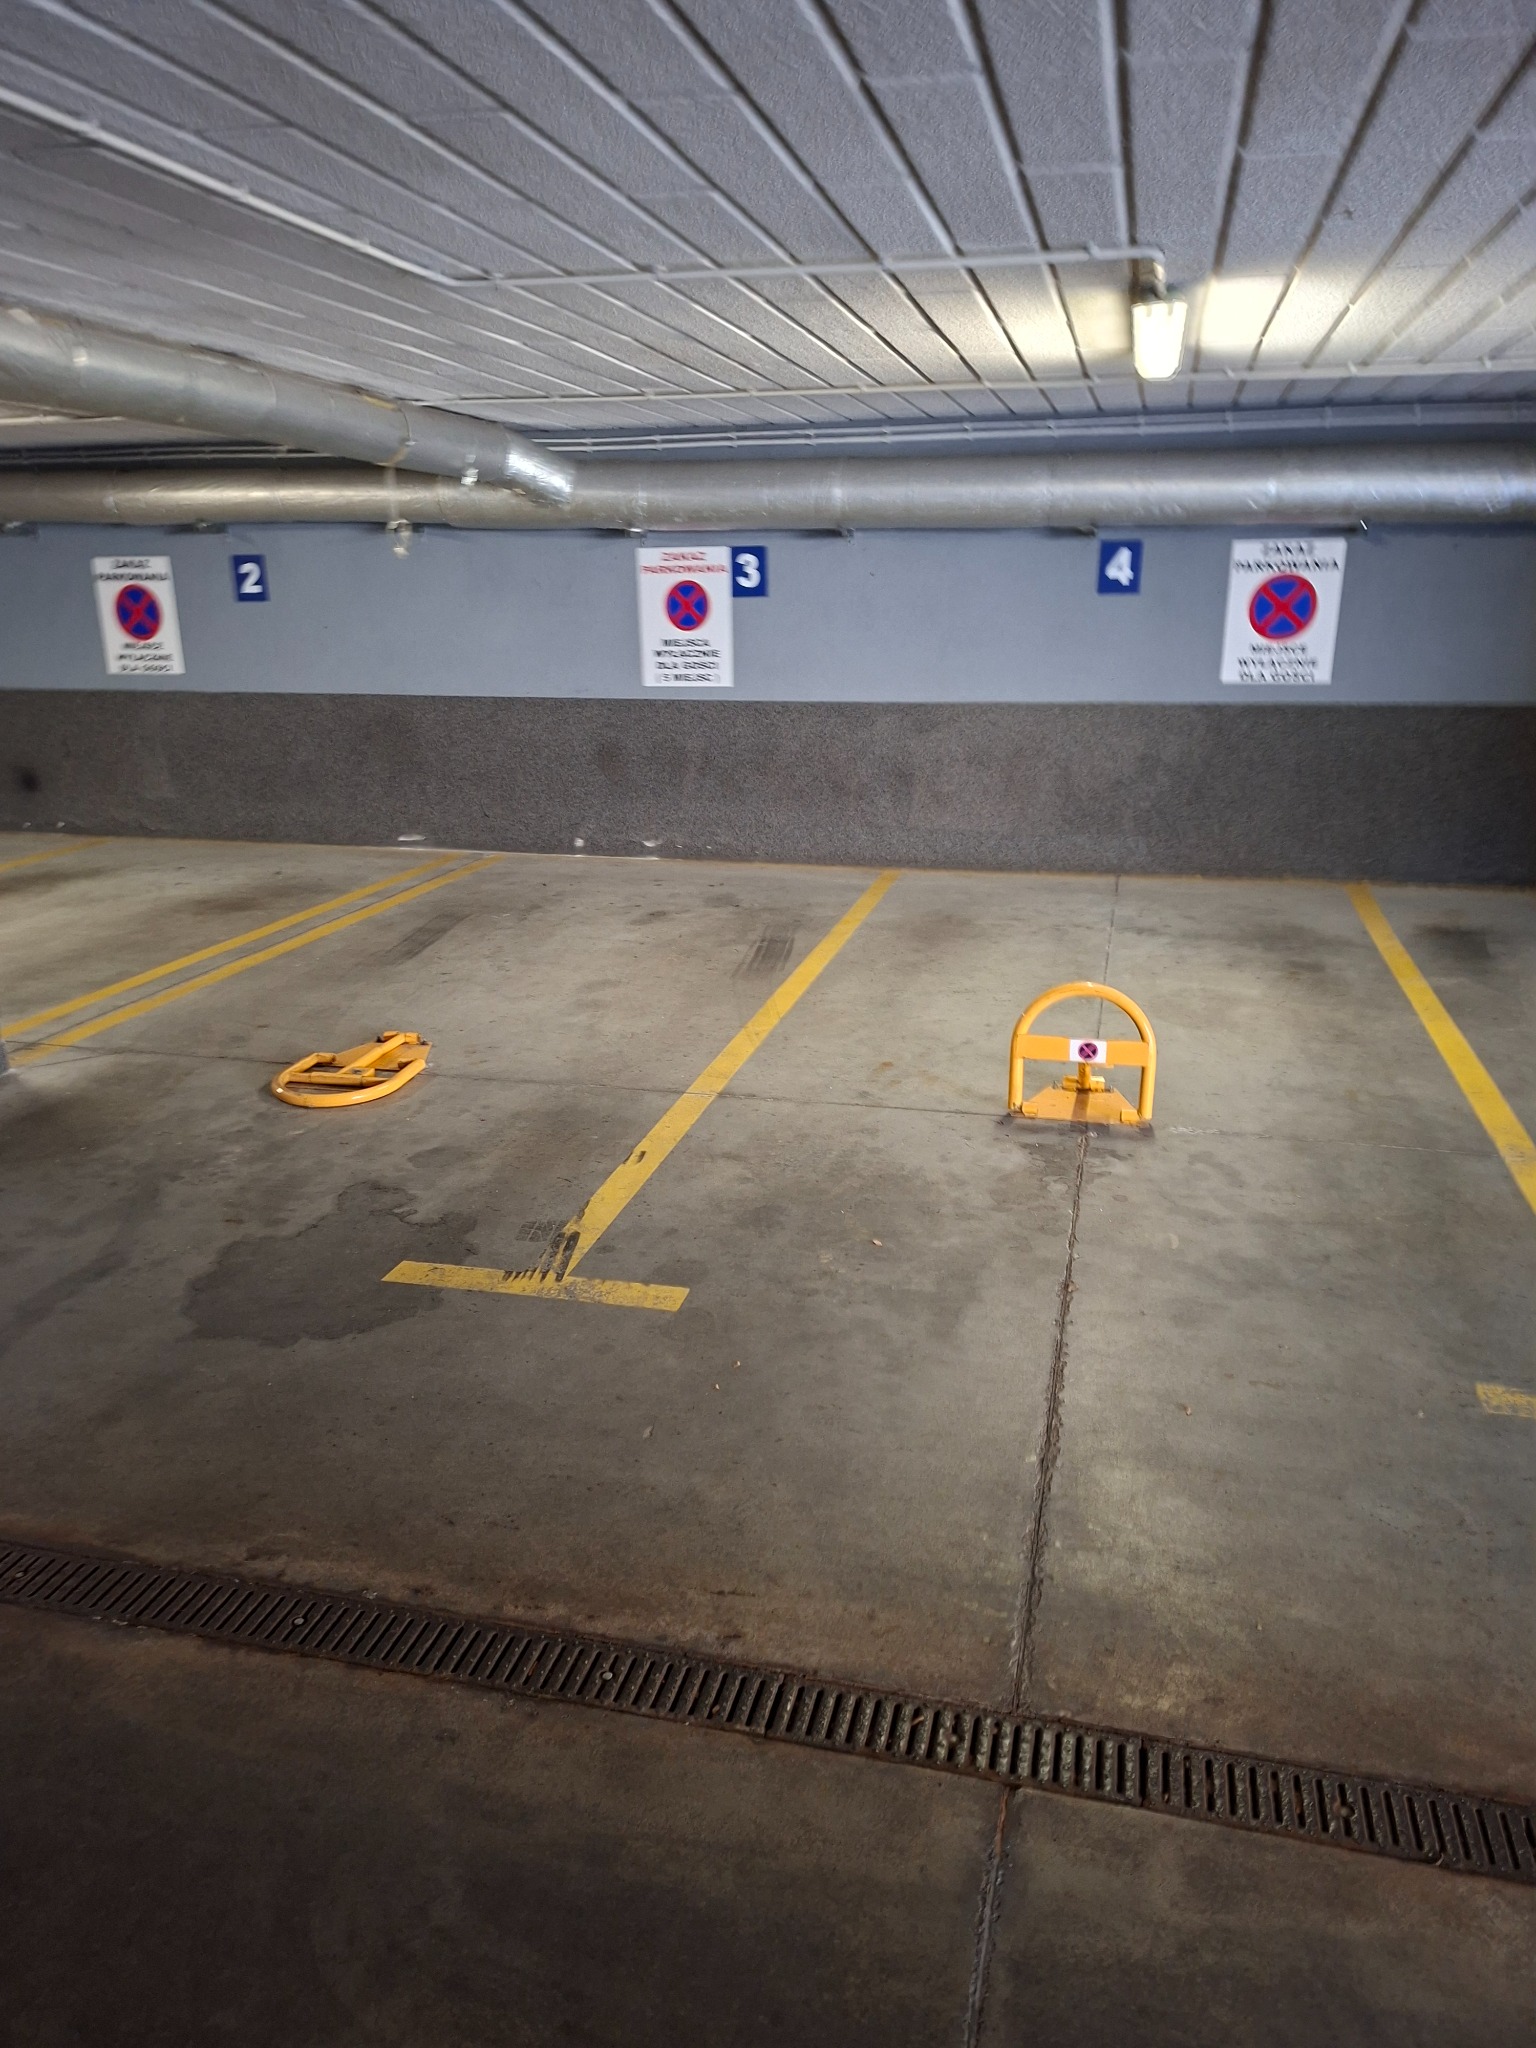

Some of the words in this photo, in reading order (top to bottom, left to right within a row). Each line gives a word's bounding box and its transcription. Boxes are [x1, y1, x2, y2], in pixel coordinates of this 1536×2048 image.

[237, 561, 263, 594] 2
[735, 552, 761, 589] 3
[1105, 546, 1134, 587] 4
